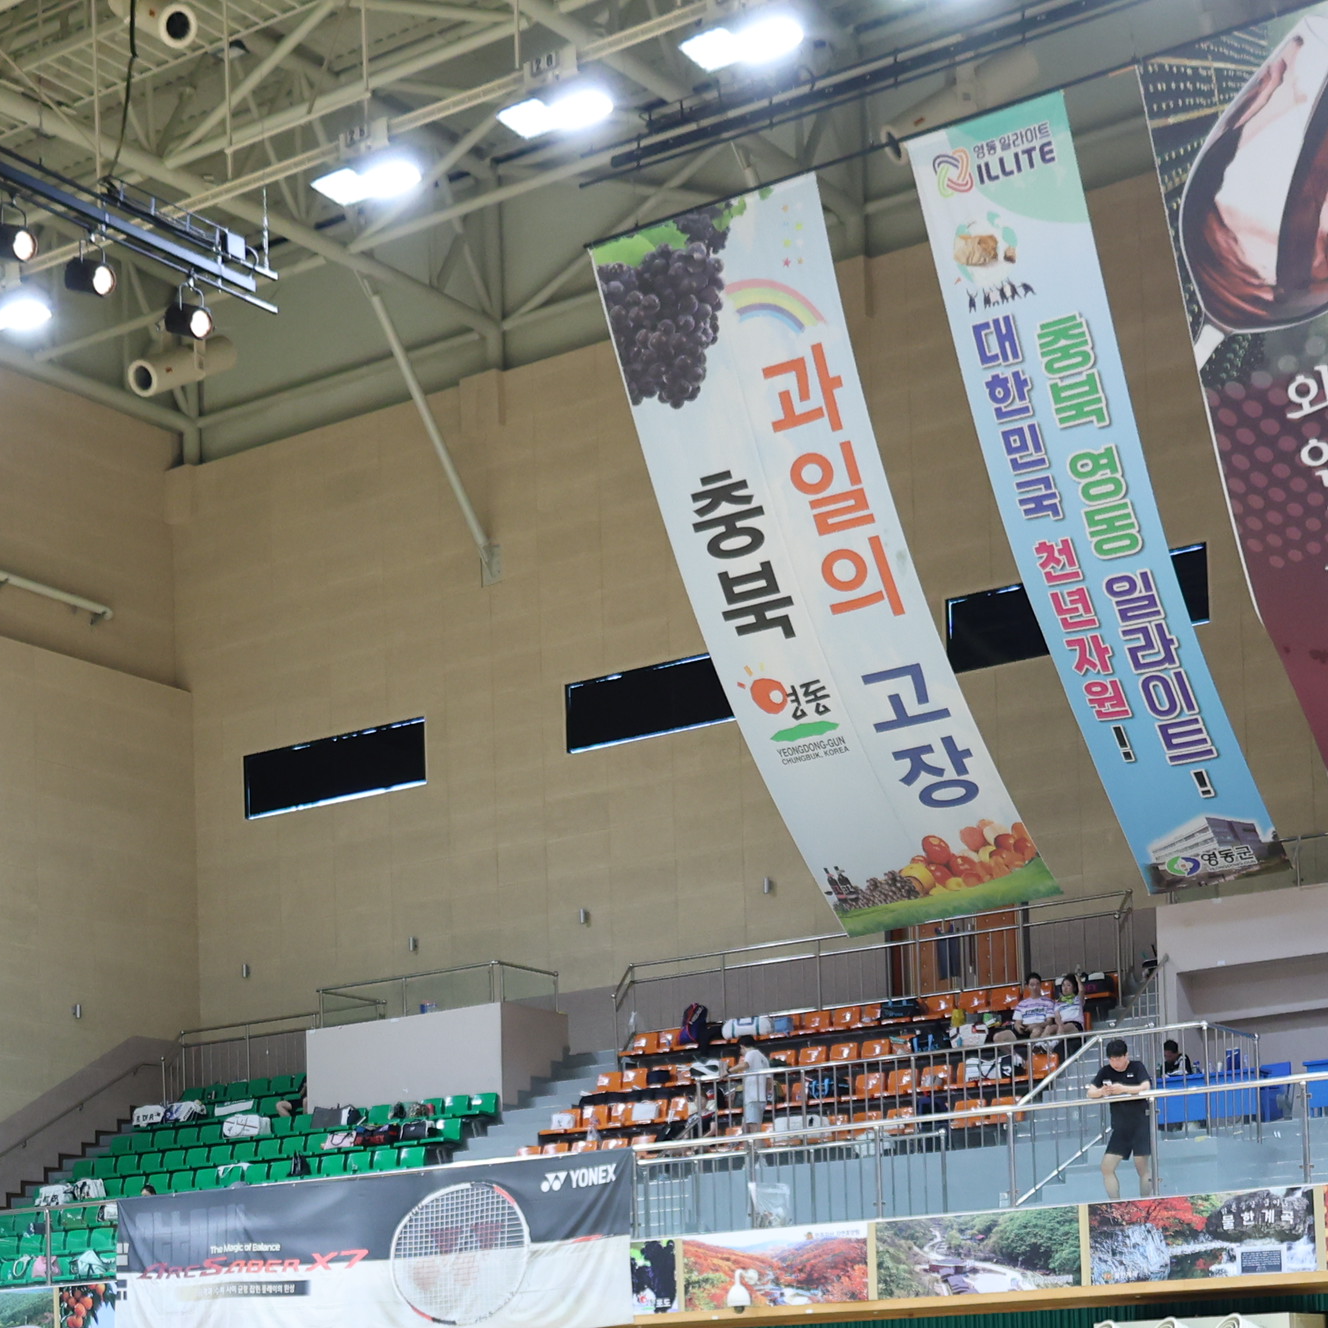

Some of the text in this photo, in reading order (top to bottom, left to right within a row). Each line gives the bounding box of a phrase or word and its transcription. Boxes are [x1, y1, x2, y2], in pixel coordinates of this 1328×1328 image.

[973, 122, 1051, 159] 영동 일라이트
[976, 140, 1056, 185] ILLITE
[1036, 312, 1110, 429] 충북
[971, 313, 1065, 521] 대한민국
[1067, 443, 1144, 560] 영동
[691, 470, 798, 640] 충북
[761, 342, 981, 809] 과일의 고장
[776, 736, 847, 758] YEONGDONG-GUN
[824, 746, 850, 757] KOREA
[1200, 845, 1254, 867] 영동군
[569, 1163, 617, 1189] YONEX
[1222, 1208, 1294, 1230] 물한계곡
[210, 1242, 280, 1255] The Magic of Balance
[305, 1249, 369, 1273] X7
